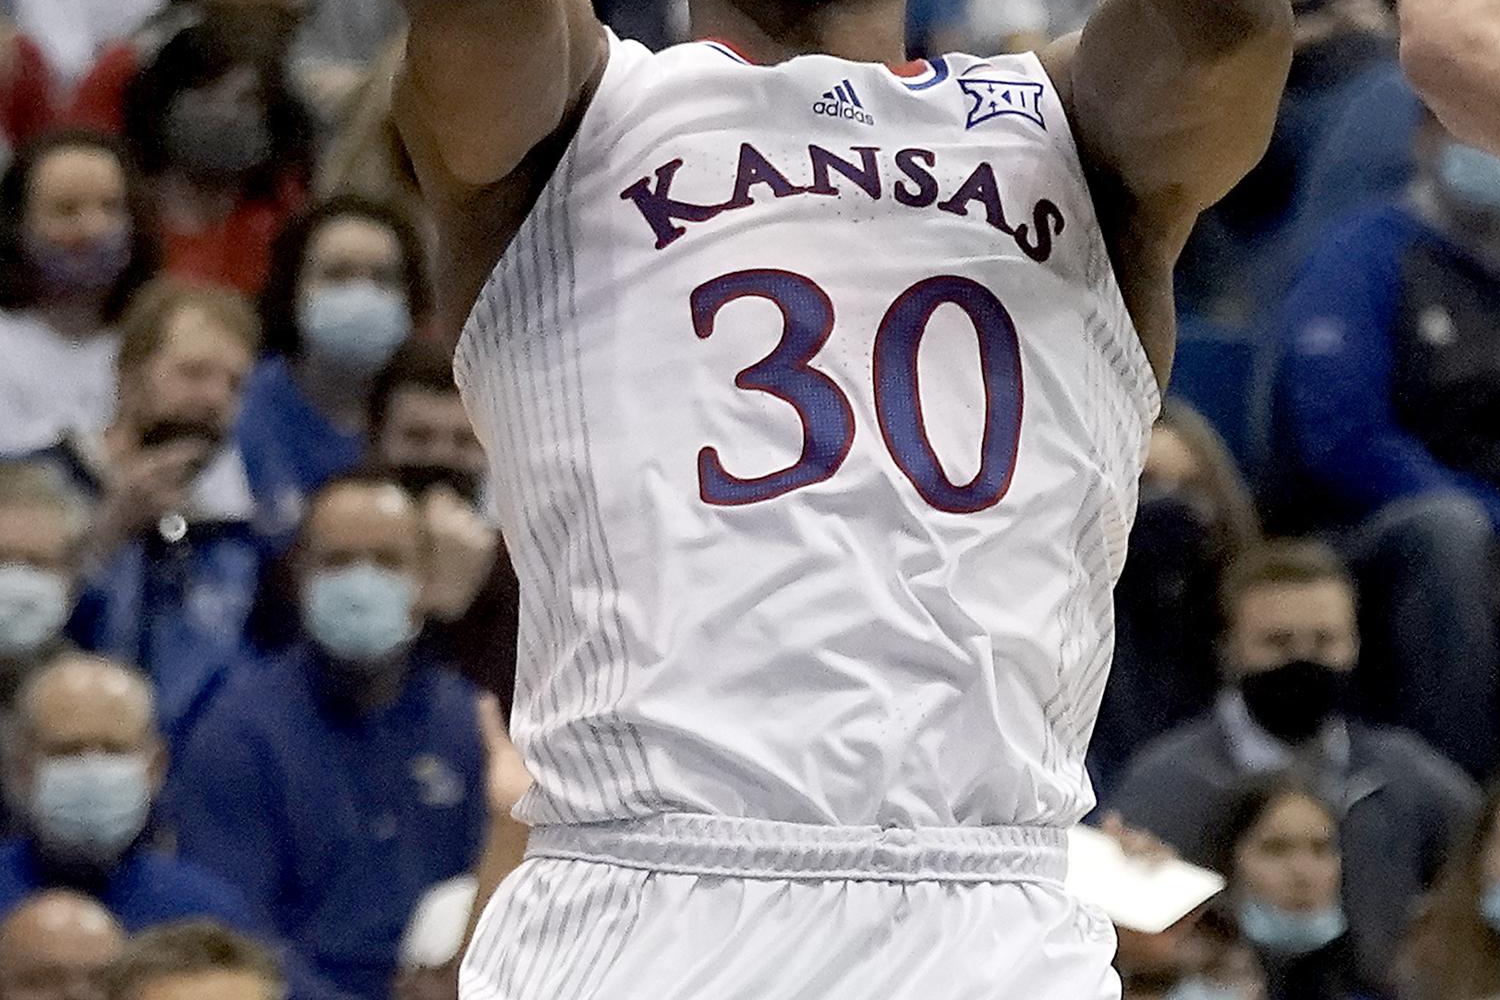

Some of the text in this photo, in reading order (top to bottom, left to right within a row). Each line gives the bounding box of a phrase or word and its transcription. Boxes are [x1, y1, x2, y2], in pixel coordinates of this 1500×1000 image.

[812, 101, 875, 126] adidas
[620, 142, 1065, 262] KANSAS
[689, 268, 1024, 514] 30
